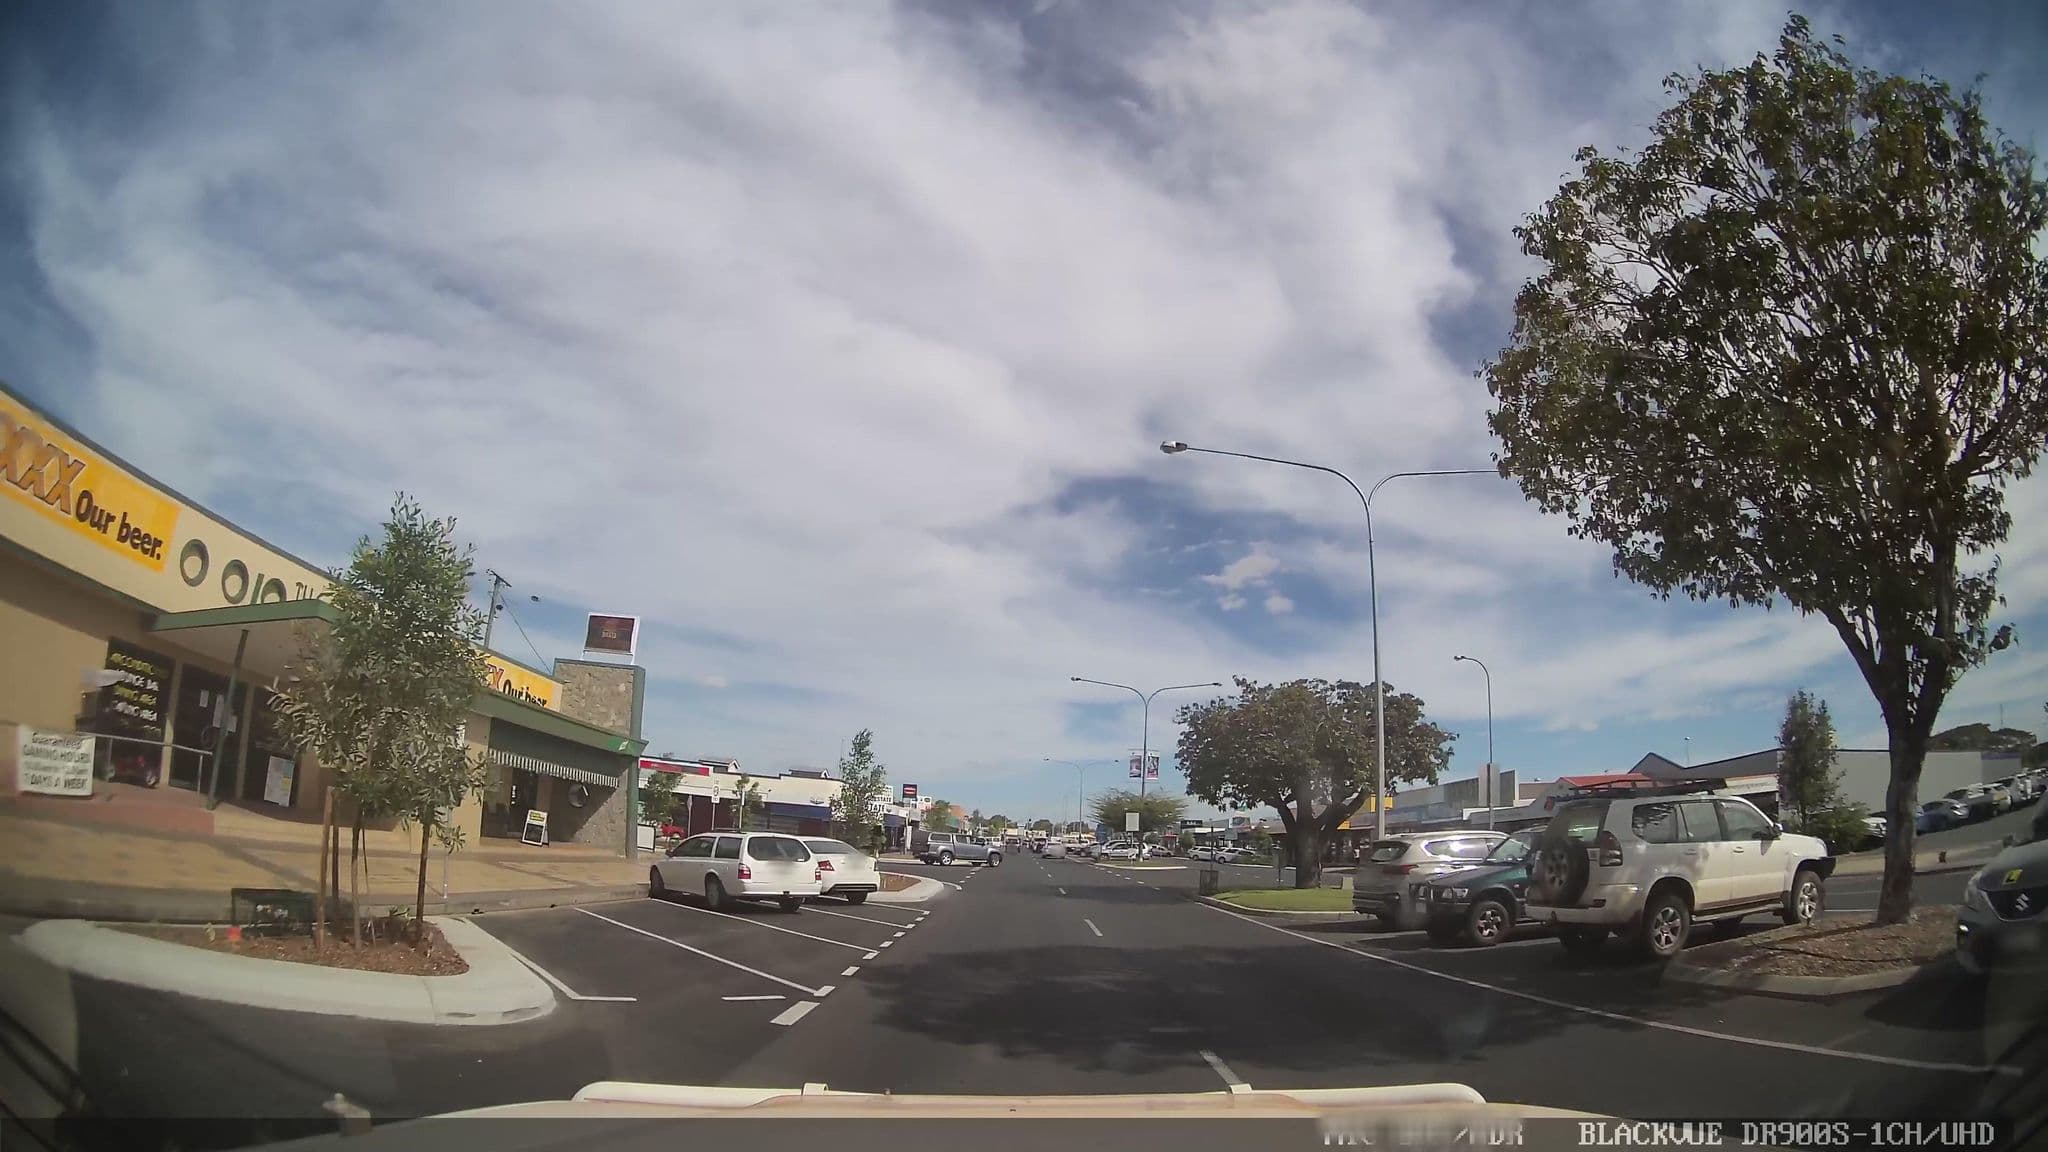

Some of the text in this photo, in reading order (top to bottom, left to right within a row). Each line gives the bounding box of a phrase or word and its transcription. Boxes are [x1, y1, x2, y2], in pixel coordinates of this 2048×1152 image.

[76, 489, 117, 534] Our
[116, 512, 163, 561] beer.
[63, 777, 88, 790] WEEK
